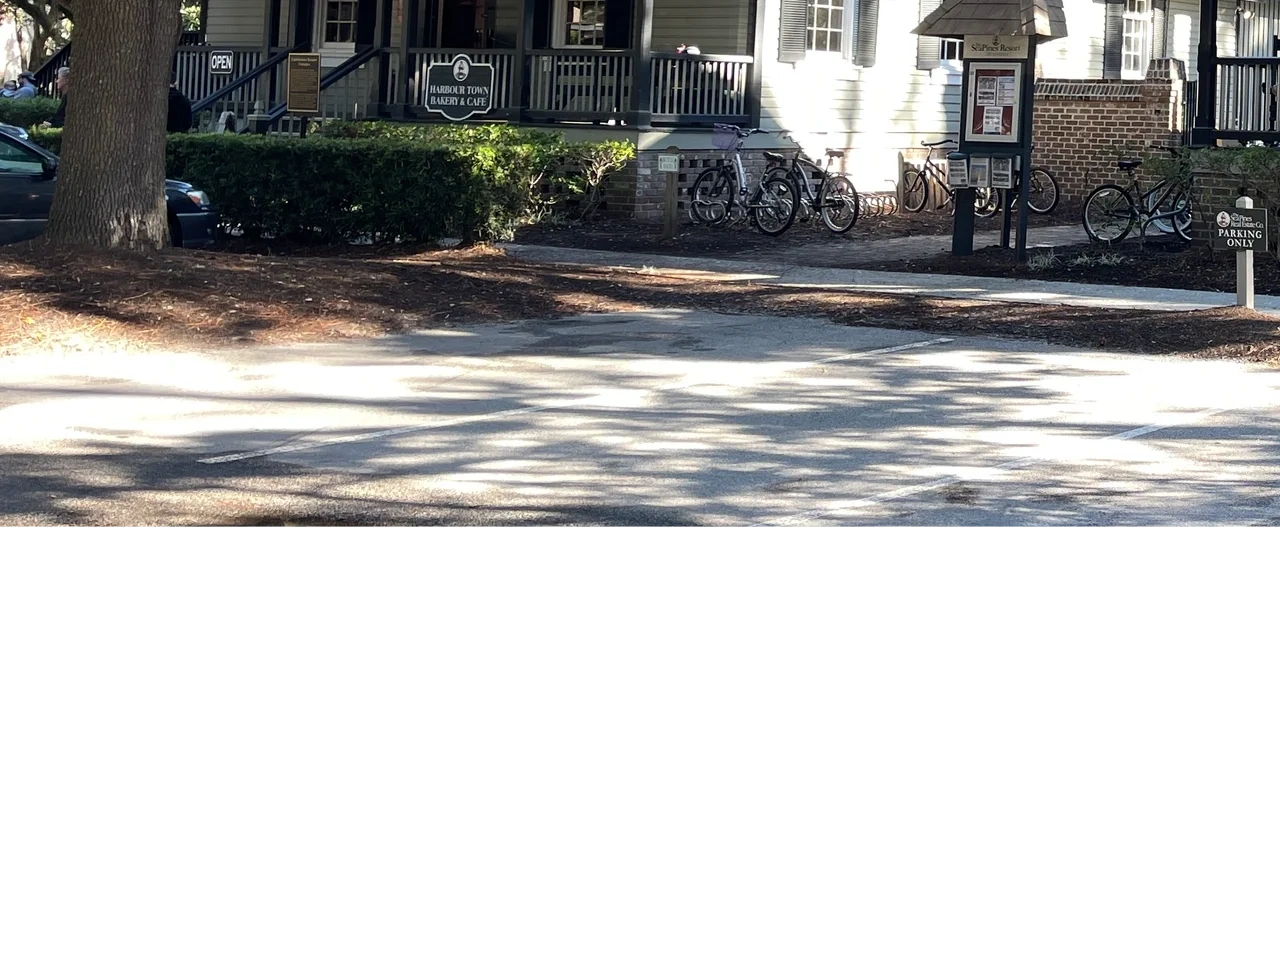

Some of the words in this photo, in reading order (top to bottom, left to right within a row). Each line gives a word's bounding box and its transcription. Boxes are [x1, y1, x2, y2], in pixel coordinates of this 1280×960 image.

[1000, 44, 1021, 52] Resort
[211, 55, 232, 69] OPEN
[429, 85, 466, 95] HARBOUR
[466, 86, 490, 96] TOWN
[430, 96, 460, 106] BAKERY
[459, 97, 466, 106] &
[466, 97, 487, 107] CAFE
[1218, 228, 1263, 239] PARKING
[1227, 238, 1254, 248] ONLY
